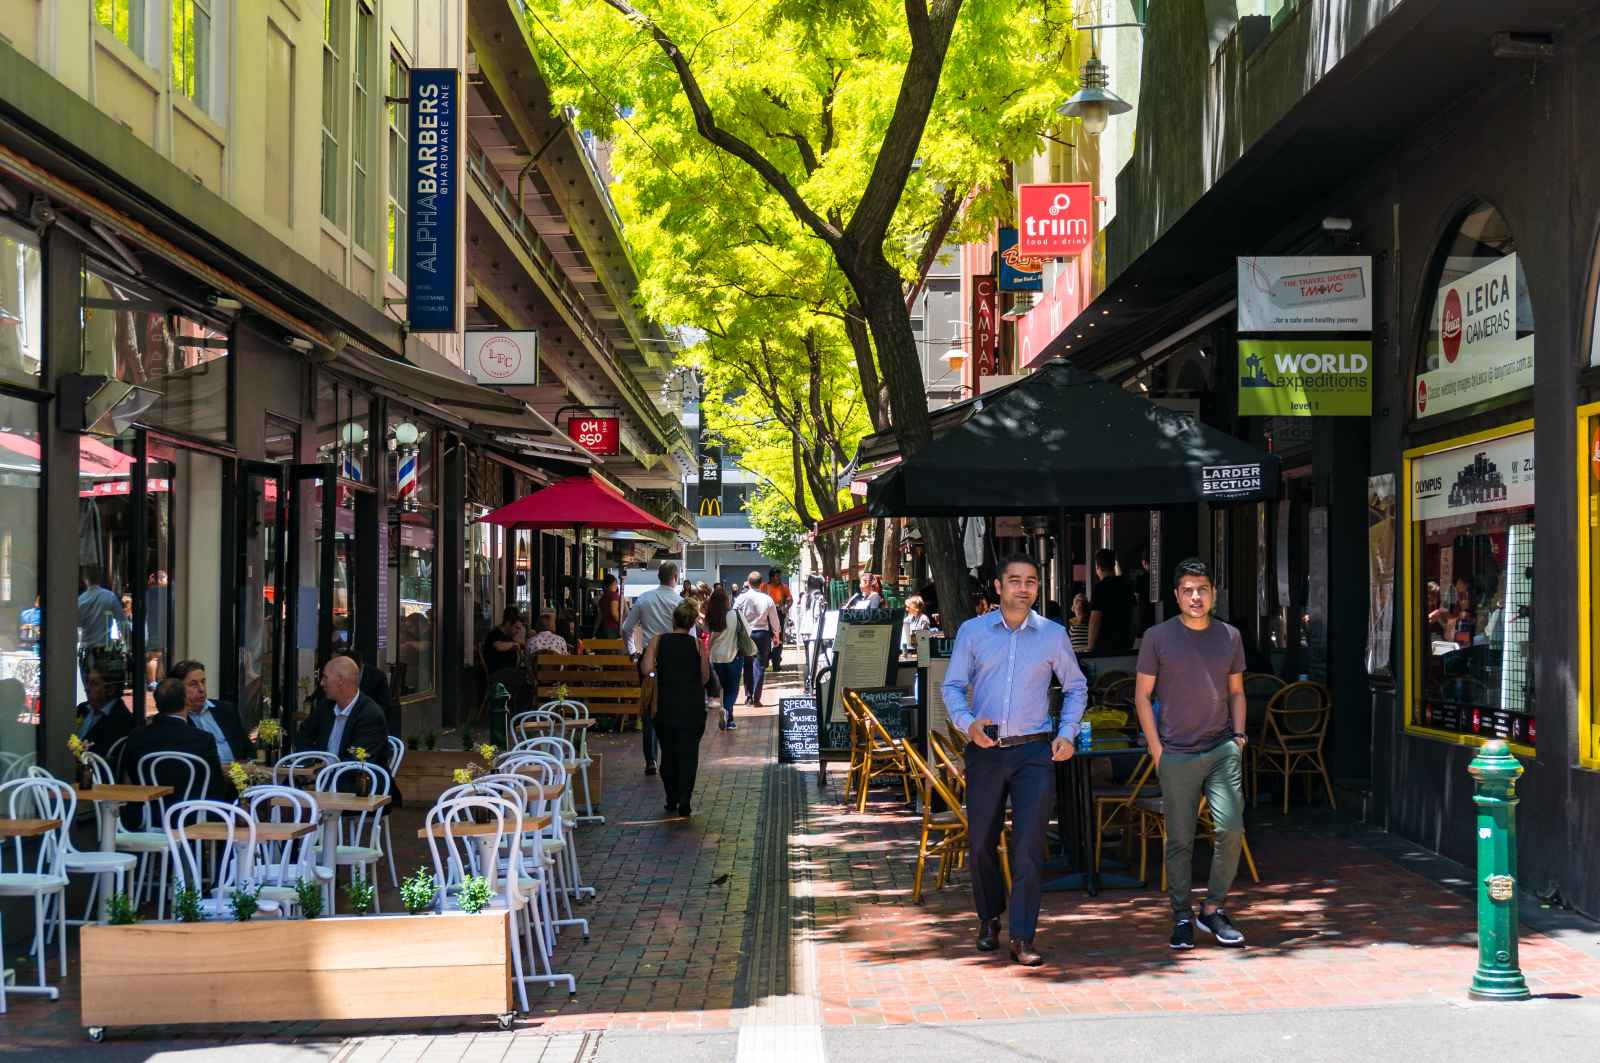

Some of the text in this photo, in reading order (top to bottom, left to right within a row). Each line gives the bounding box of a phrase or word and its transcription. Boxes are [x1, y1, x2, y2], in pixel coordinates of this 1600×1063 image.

[440, 83, 450, 195] @HARDWARE LANE
[1026, 238, 1048, 246] food
[1061, 238, 1087, 246] drink
[1466, 274, 1510, 317] LEICA
[1315, 317, 1335, 325] healthy
[1466, 309, 1510, 345] CAMERAS
[1274, 353, 1368, 374] WORLD
[1276, 374, 1368, 393] expeditions
[1290, 401, 1312, 411] level
[580, 420, 599, 433] OH
[1202, 467, 1261, 479] LARDER
[1202, 479, 1261, 490] SECTION
[1415, 476, 1442, 494] OLYMPUS
